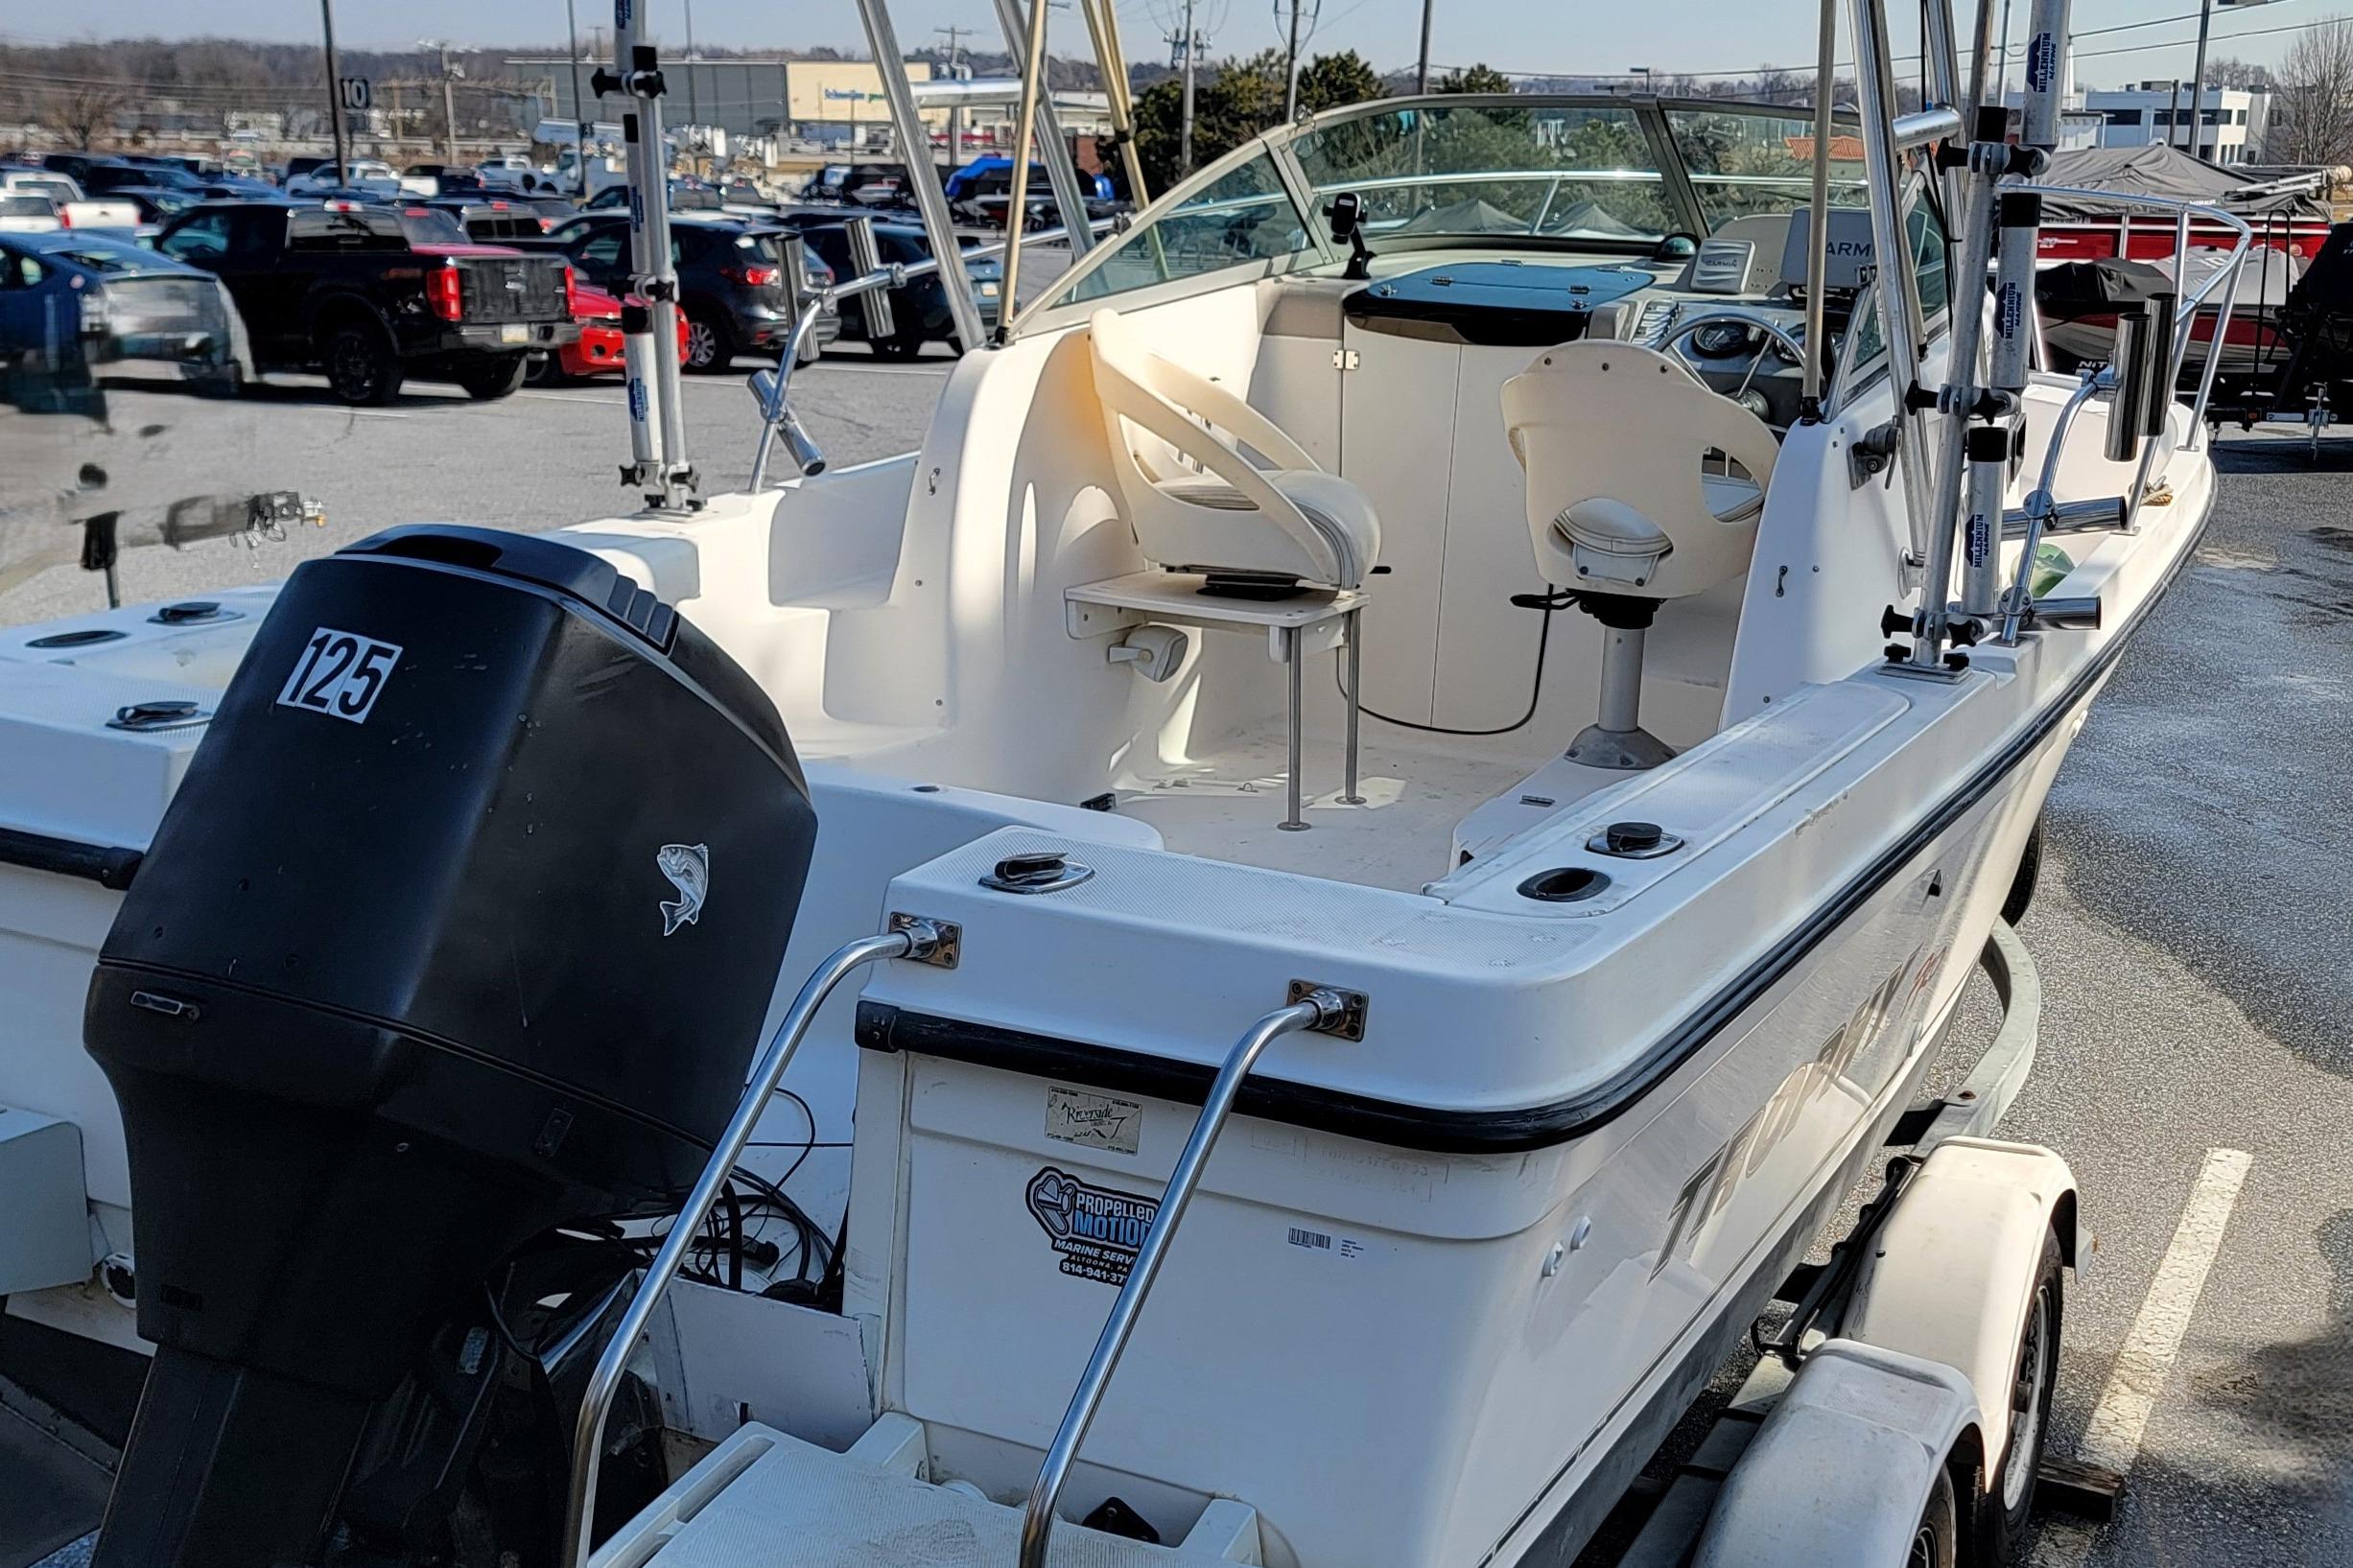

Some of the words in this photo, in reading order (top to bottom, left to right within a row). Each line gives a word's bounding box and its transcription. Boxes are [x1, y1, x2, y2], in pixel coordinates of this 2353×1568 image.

[2037, 33, 2051, 93] MILLENNIUM
[342, 80, 367, 108] 10
[1824, 241, 1873, 257] ARM
[2005, 282, 2016, 339] MILLENNIUM
[1974, 514, 1984, 569] MILLENNIUM
[288, 633, 396, 716] 125
[1061, 1102, 1114, 1124] Riverside
[1646, 943, 1922, 1287] TROPHY
[1054, 1238, 1101, 1257] MARINE
[1102, 1250, 1136, 1265] SERV
[1062, 1262, 1127, 1284] 814-941-37
[1117, 1264, 1128, 1273] PA
